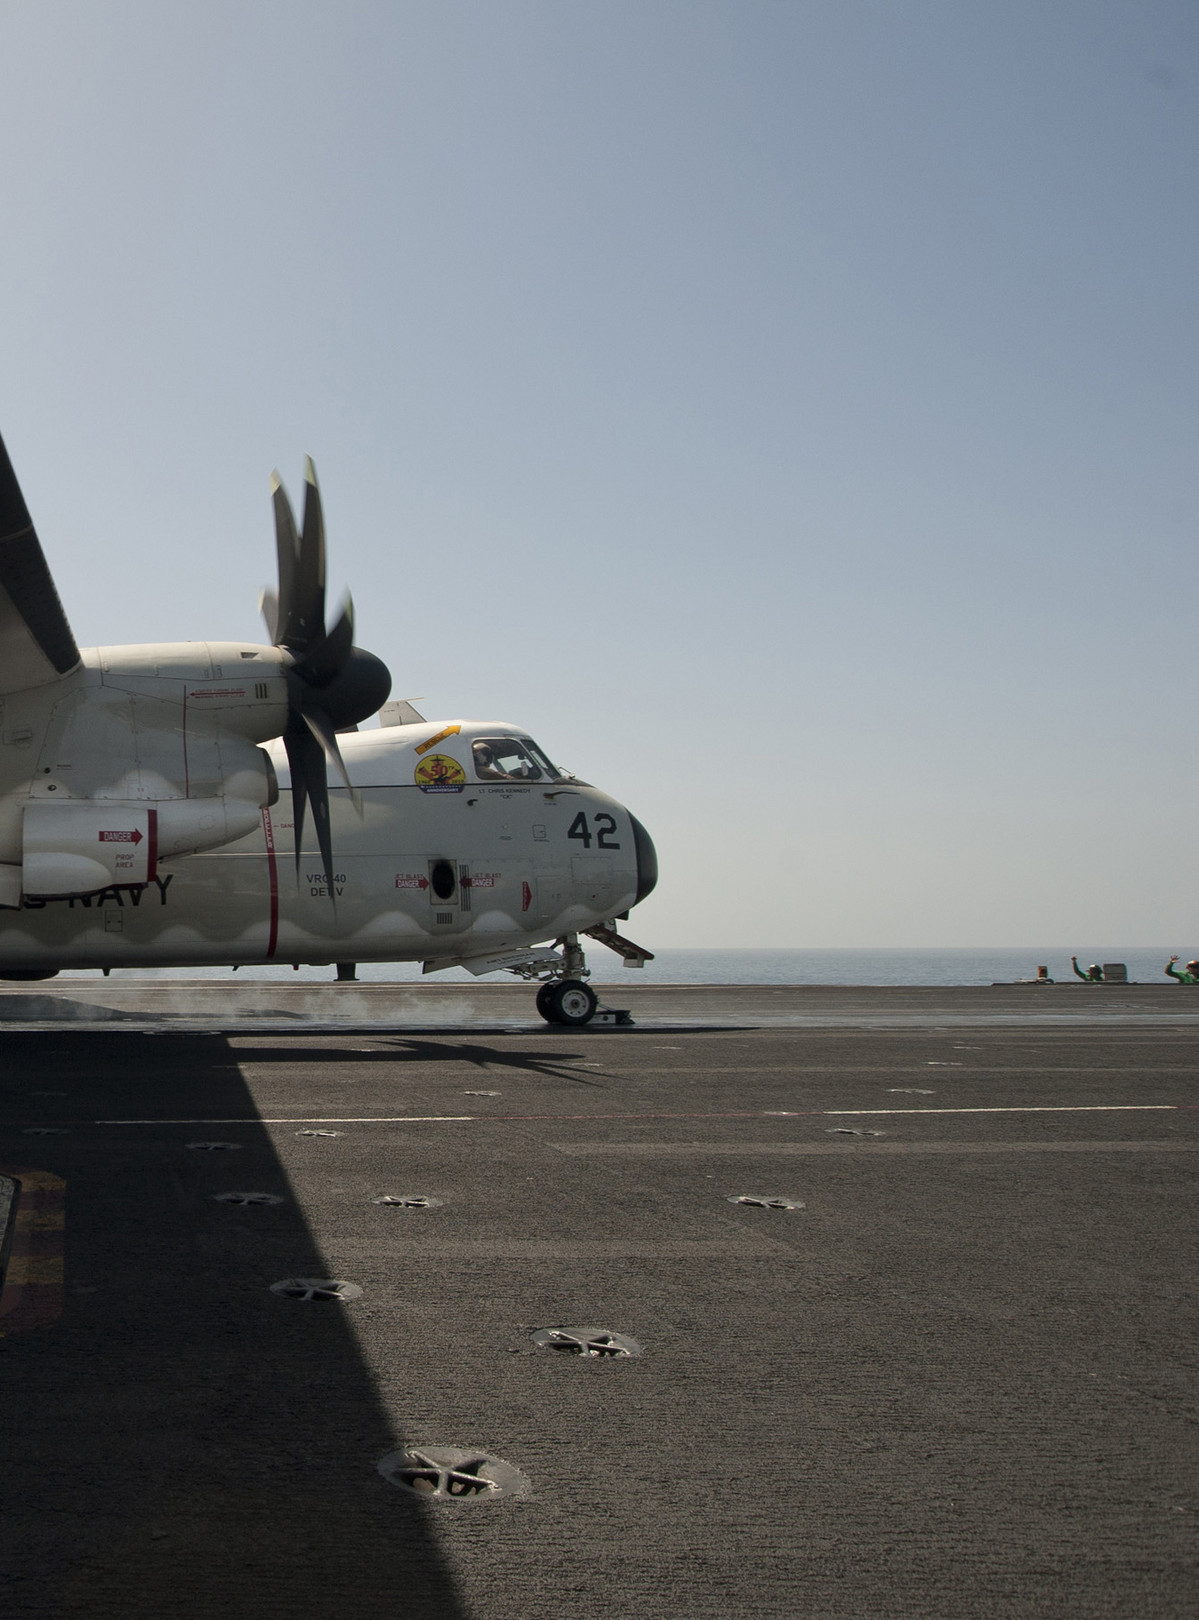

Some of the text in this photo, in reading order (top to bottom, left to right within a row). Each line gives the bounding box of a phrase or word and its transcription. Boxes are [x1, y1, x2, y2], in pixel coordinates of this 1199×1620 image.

[568, 811, 620, 850] 42
[103, 832, 132, 841] DANGER
[397, 880, 420, 888] DANGER
[471, 879, 493, 887] DANGER
[336, 887, 344, 897] V
